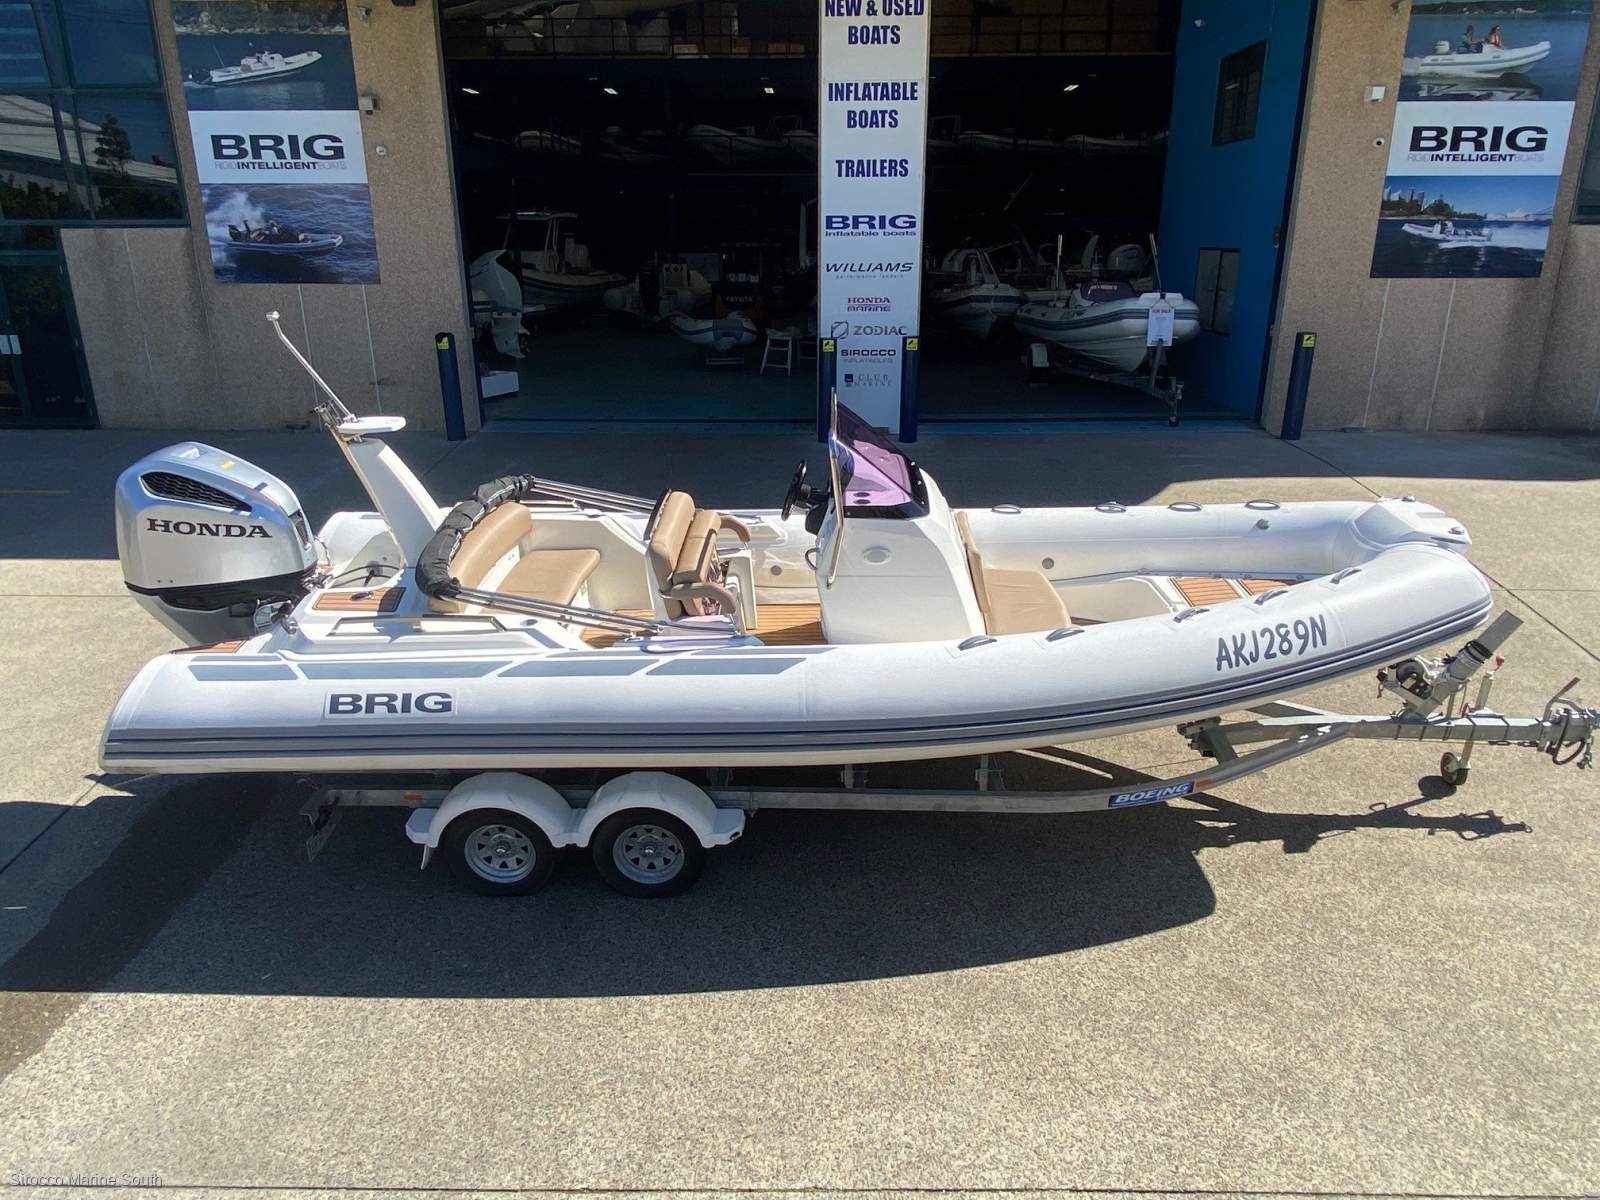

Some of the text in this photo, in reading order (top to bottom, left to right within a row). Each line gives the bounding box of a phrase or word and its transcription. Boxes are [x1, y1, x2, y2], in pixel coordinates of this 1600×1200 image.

[825, 0, 924, 17] NEW & USED
[848, 25, 901, 45] BOATS
[828, 82, 918, 101] INFLATABLE
[847, 109, 899, 129] BOATS
[210, 134, 345, 161] BRIG
[1409, 126, 1549, 152] BRIG
[835, 159, 909, 178] TRAILERS
[825, 215, 917, 230] BRIG
[825, 262, 914, 273] WILLIAMS
[853, 325, 908, 336] ZODIAC
[840, 349, 897, 357] SIROCCO
[146, 518, 273, 538] HONDA
[1216, 614, 1327, 671] AKJ289N
[329, 692, 453, 715] BRIG
[1115, 783, 1190, 803] BOEING
